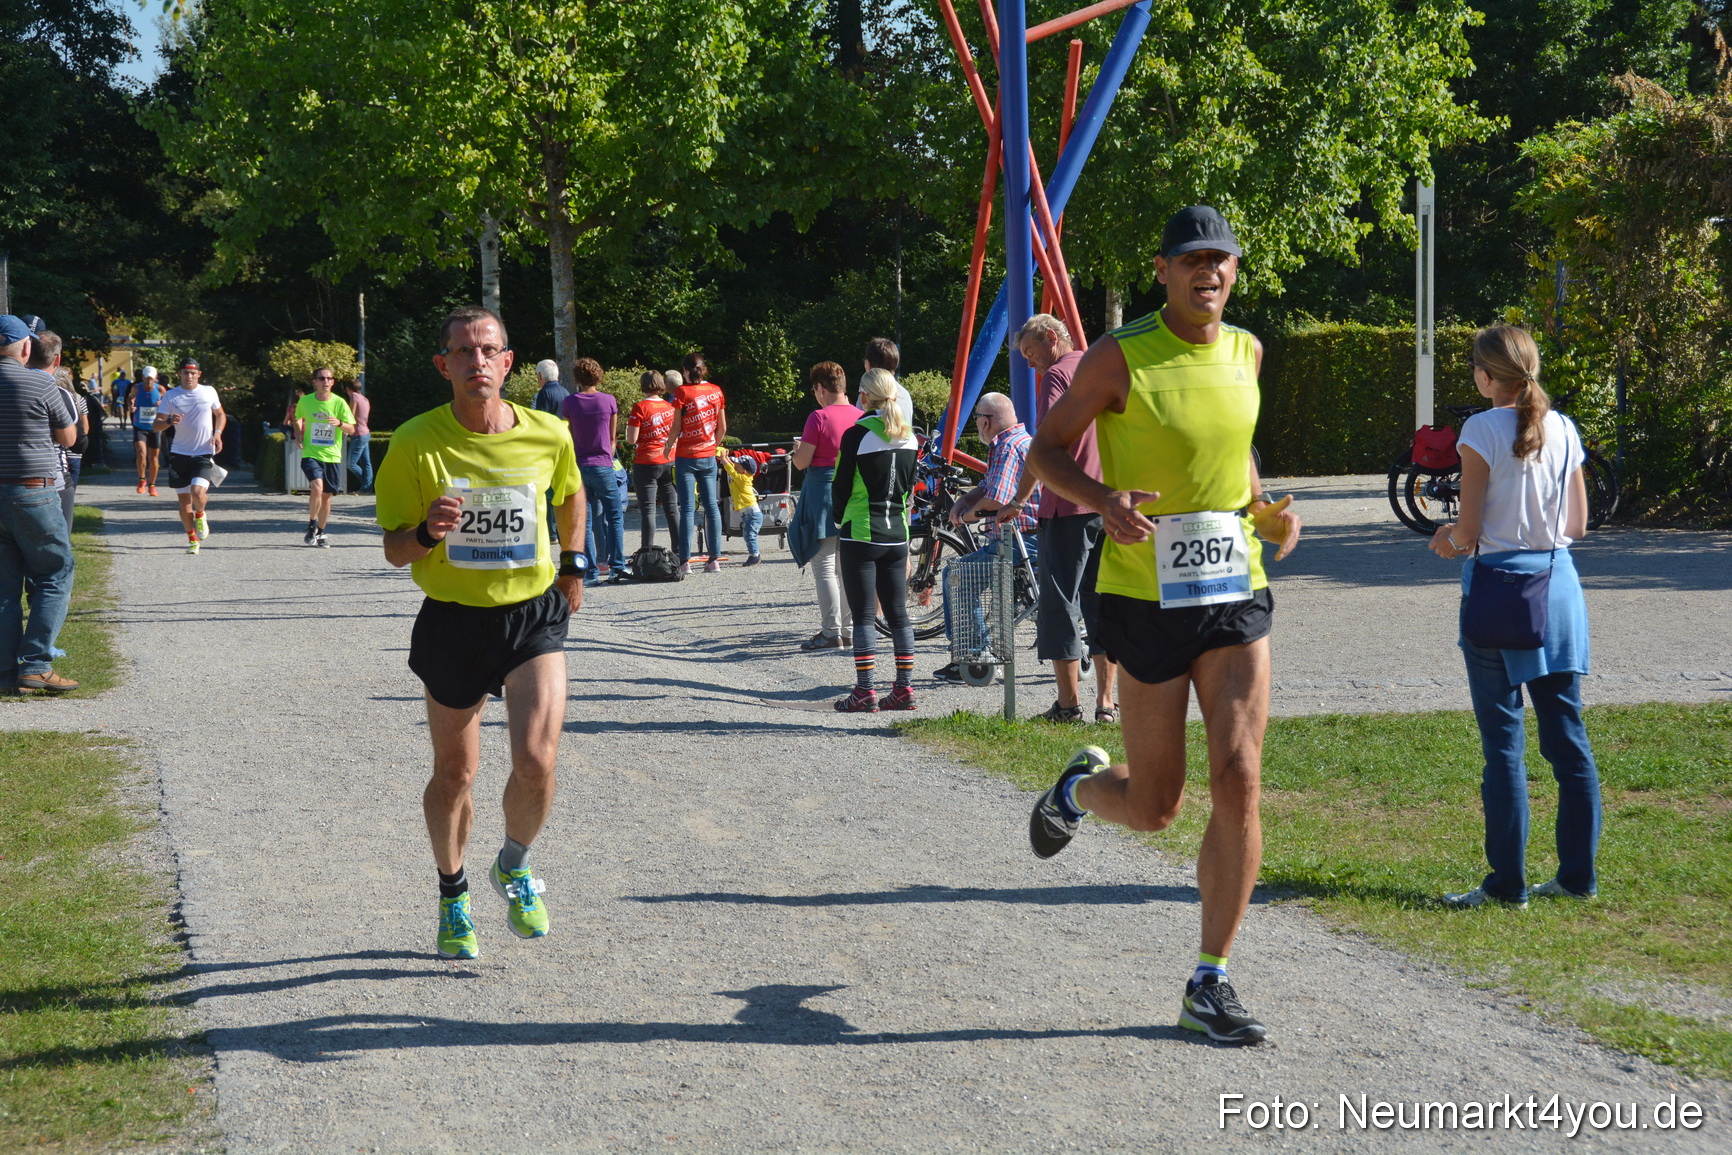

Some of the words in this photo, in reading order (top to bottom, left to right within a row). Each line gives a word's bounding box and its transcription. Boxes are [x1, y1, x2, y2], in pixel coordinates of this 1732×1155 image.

[315, 429, 332, 437] 2172
[473, 494, 512, 503] BOCK
[460, 509, 524, 534] 2545
[1183, 521, 1222, 532] BOCK
[472, 549, 513, 560] Damian
[1171, 537, 1233, 568] 2367
[1186, 583, 1228, 595] Thomas
